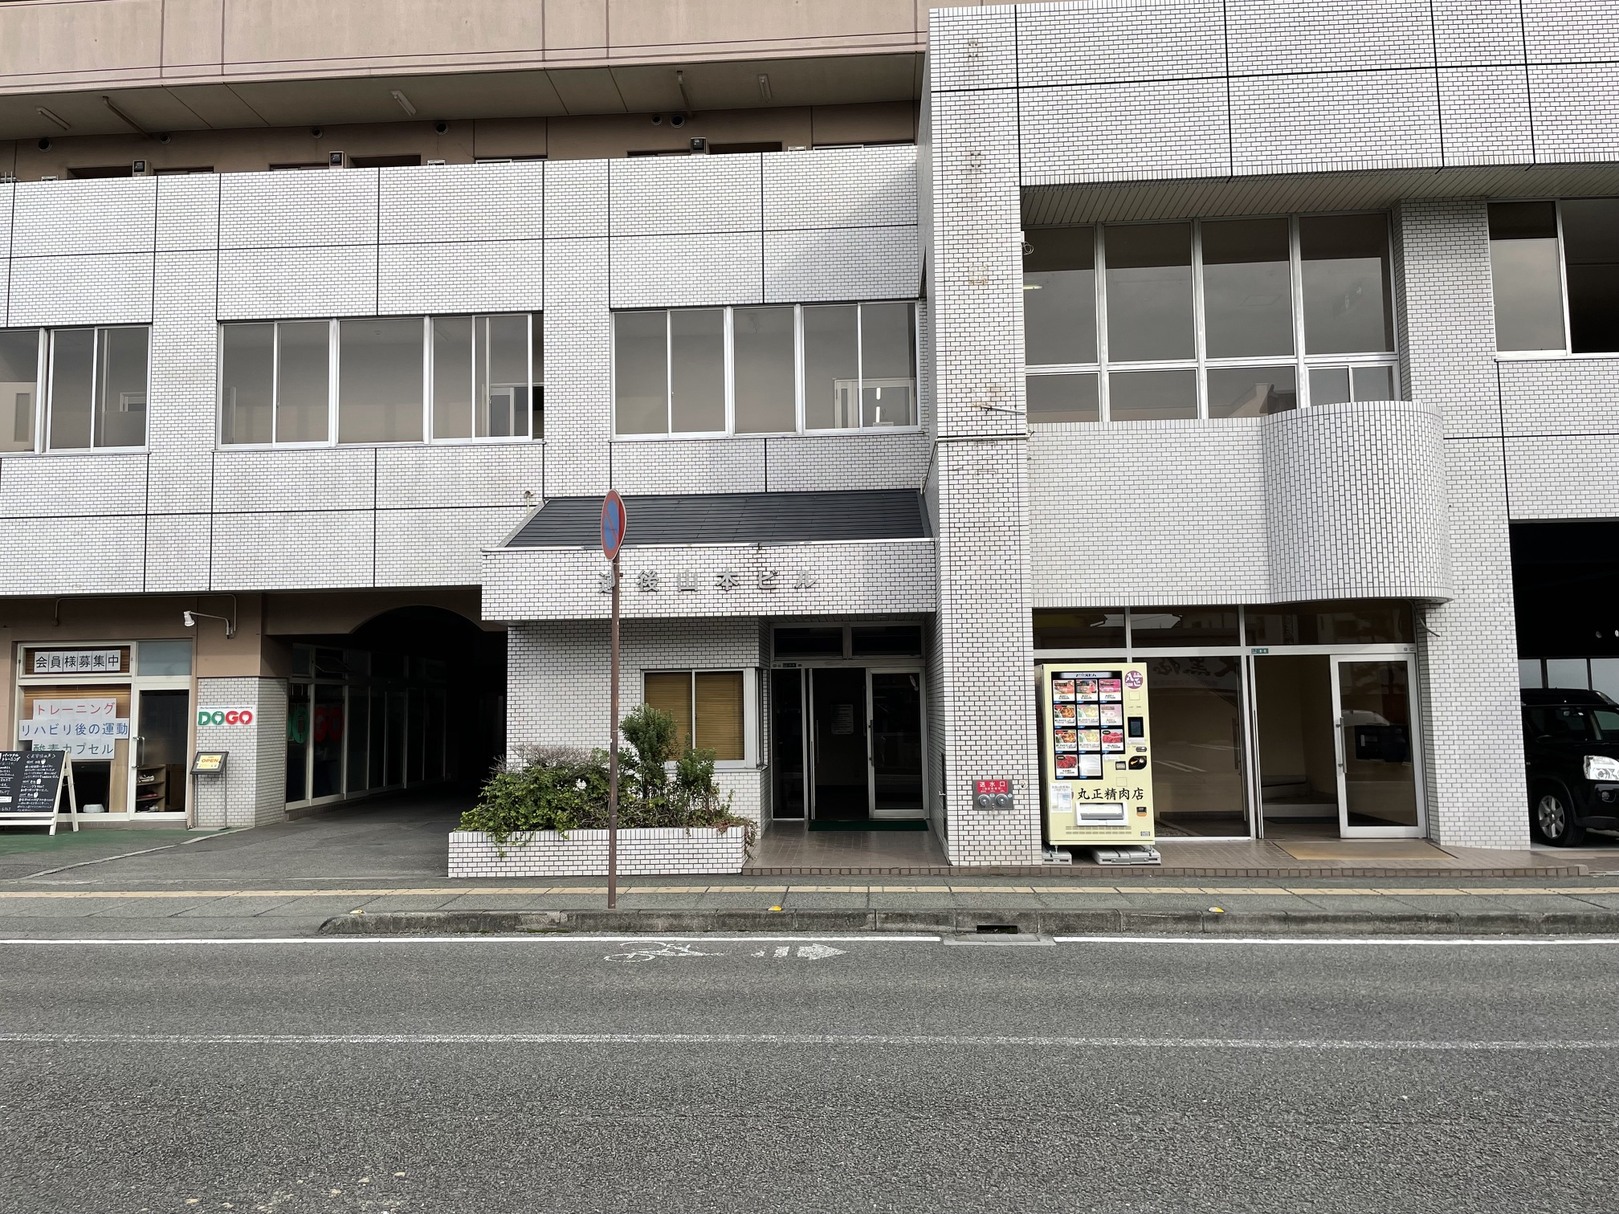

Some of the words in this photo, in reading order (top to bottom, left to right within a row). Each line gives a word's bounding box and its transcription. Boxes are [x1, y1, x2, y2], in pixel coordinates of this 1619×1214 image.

[35, 654, 119, 669] 会員様募集中
[38, 701, 115, 716] トレーニング
[198, 710, 253, 726] DOGO
[22, 722, 128, 736] リハビリ後の運動
[1076, 787, 1145, 801] 丸正精肉店
